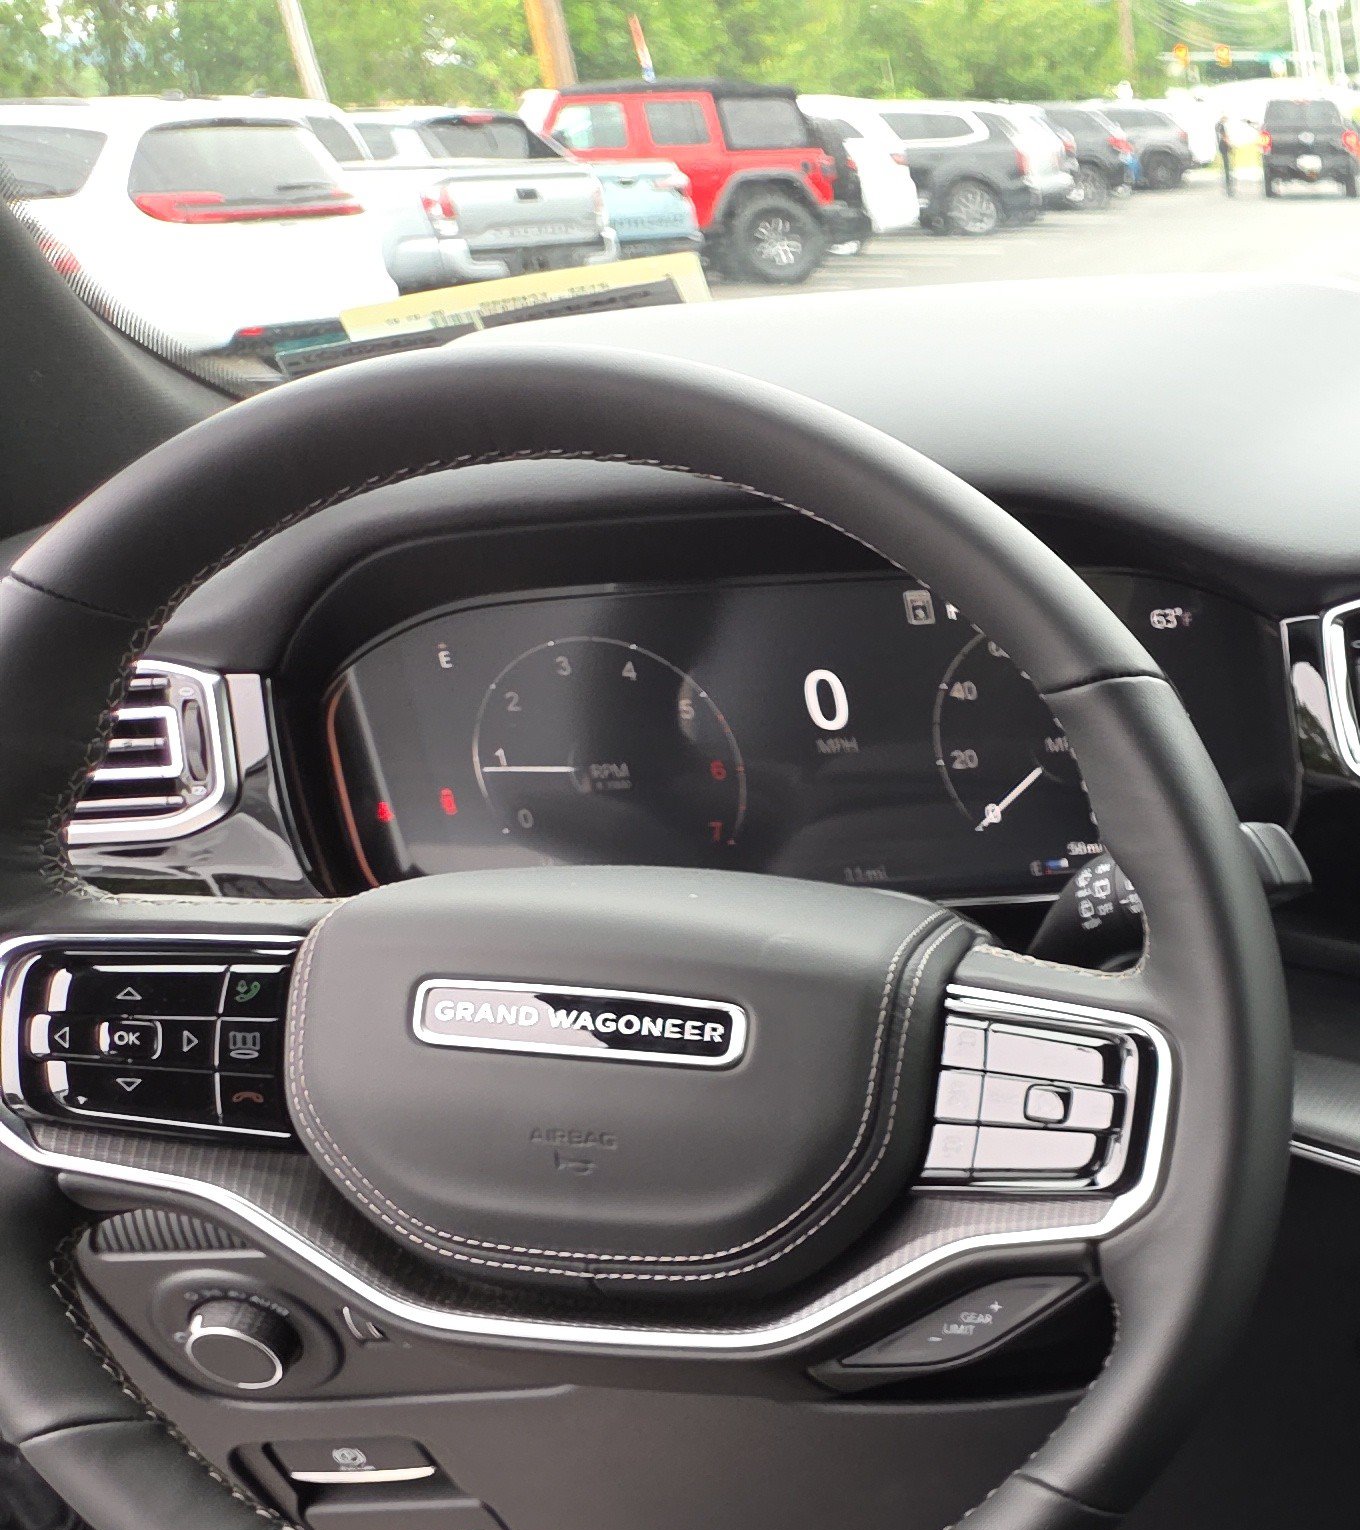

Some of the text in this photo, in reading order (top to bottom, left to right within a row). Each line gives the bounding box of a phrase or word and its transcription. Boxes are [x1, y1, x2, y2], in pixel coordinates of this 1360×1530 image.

[555, 656, 571, 676] 3
[622, 661, 637, 681] 4
[505, 692, 521, 712] 2
[804, 669, 849, 731] 0
[950, 749, 979, 770] 20
[517, 808, 534, 829] 0
[434, 1000, 725, 1043] GRAND WAGONEER
[114, 1029, 140, 1046] OK
[960, 1313, 993, 1325] GEAR
